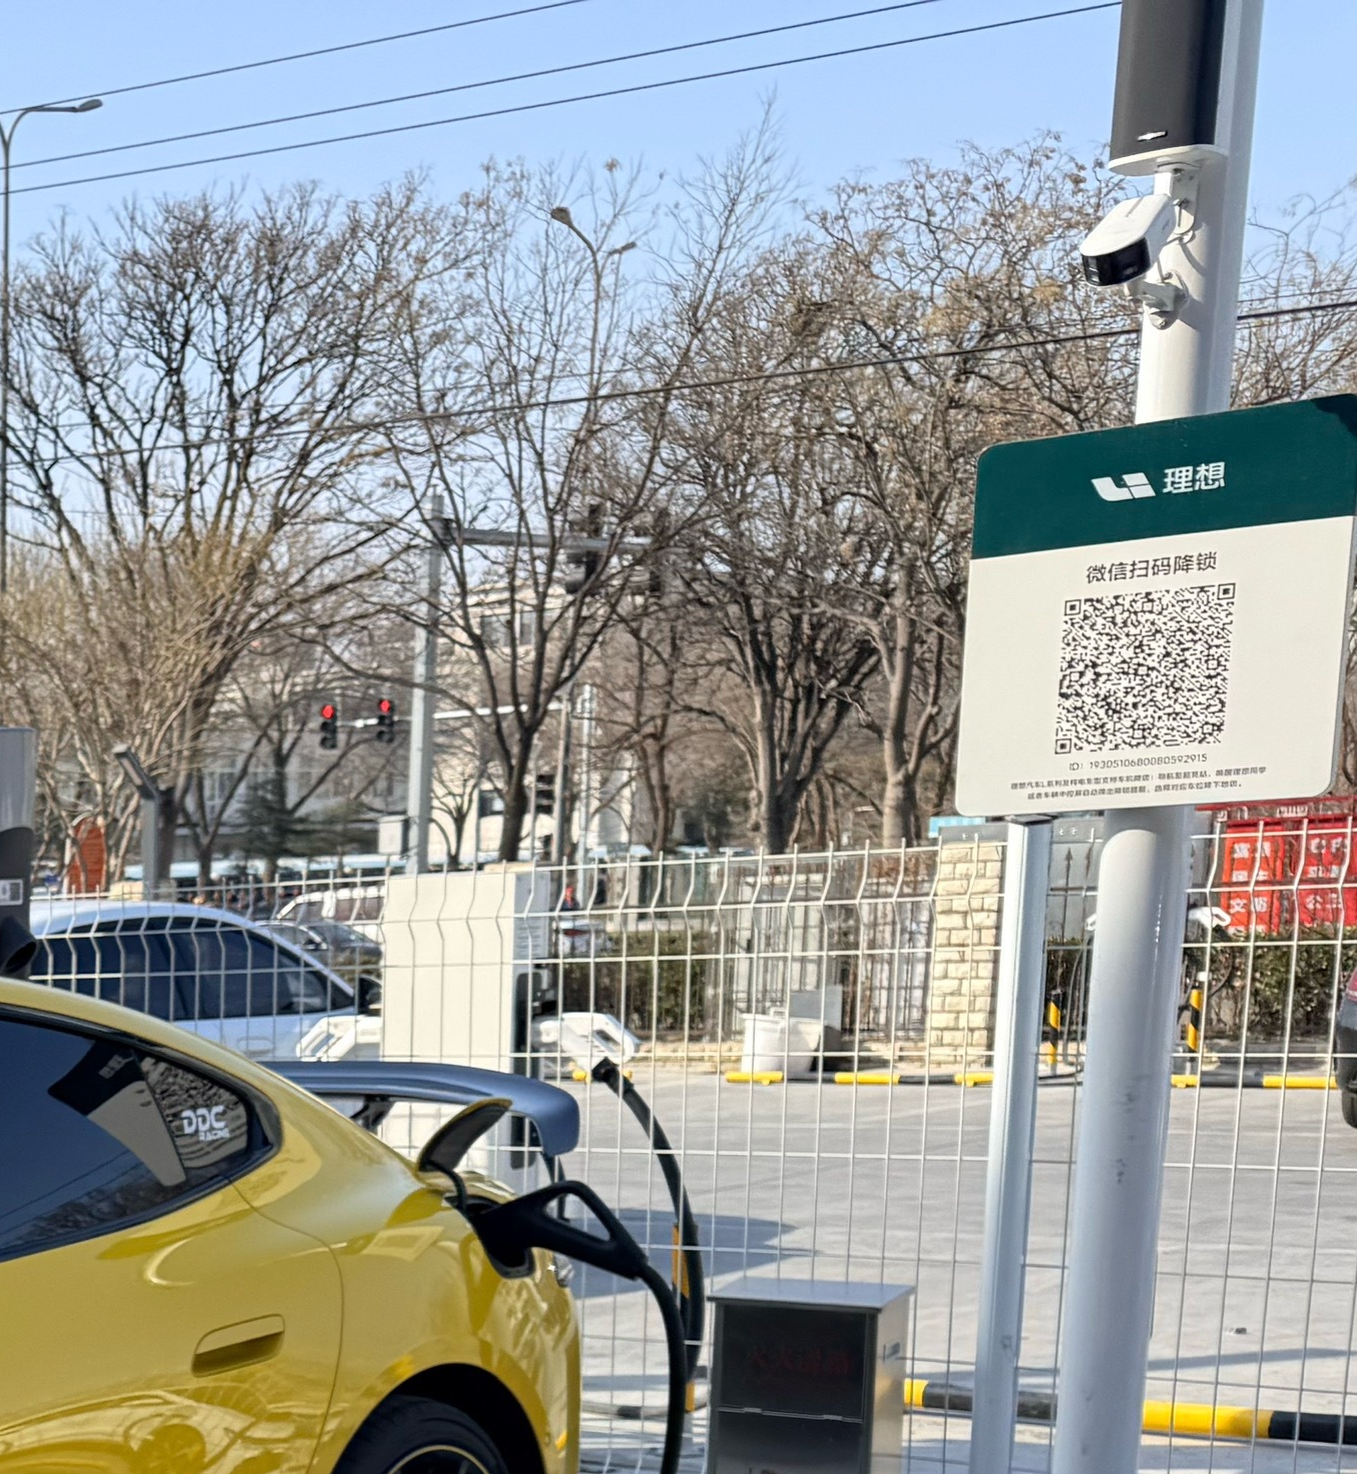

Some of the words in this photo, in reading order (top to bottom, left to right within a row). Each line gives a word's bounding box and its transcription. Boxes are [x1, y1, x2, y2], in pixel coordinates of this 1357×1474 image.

[1162, 461, 1225, 494] 理想
[1086, 551, 1217, 584] 微信扫码降锁
[180, 1104, 227, 1134] DDC
